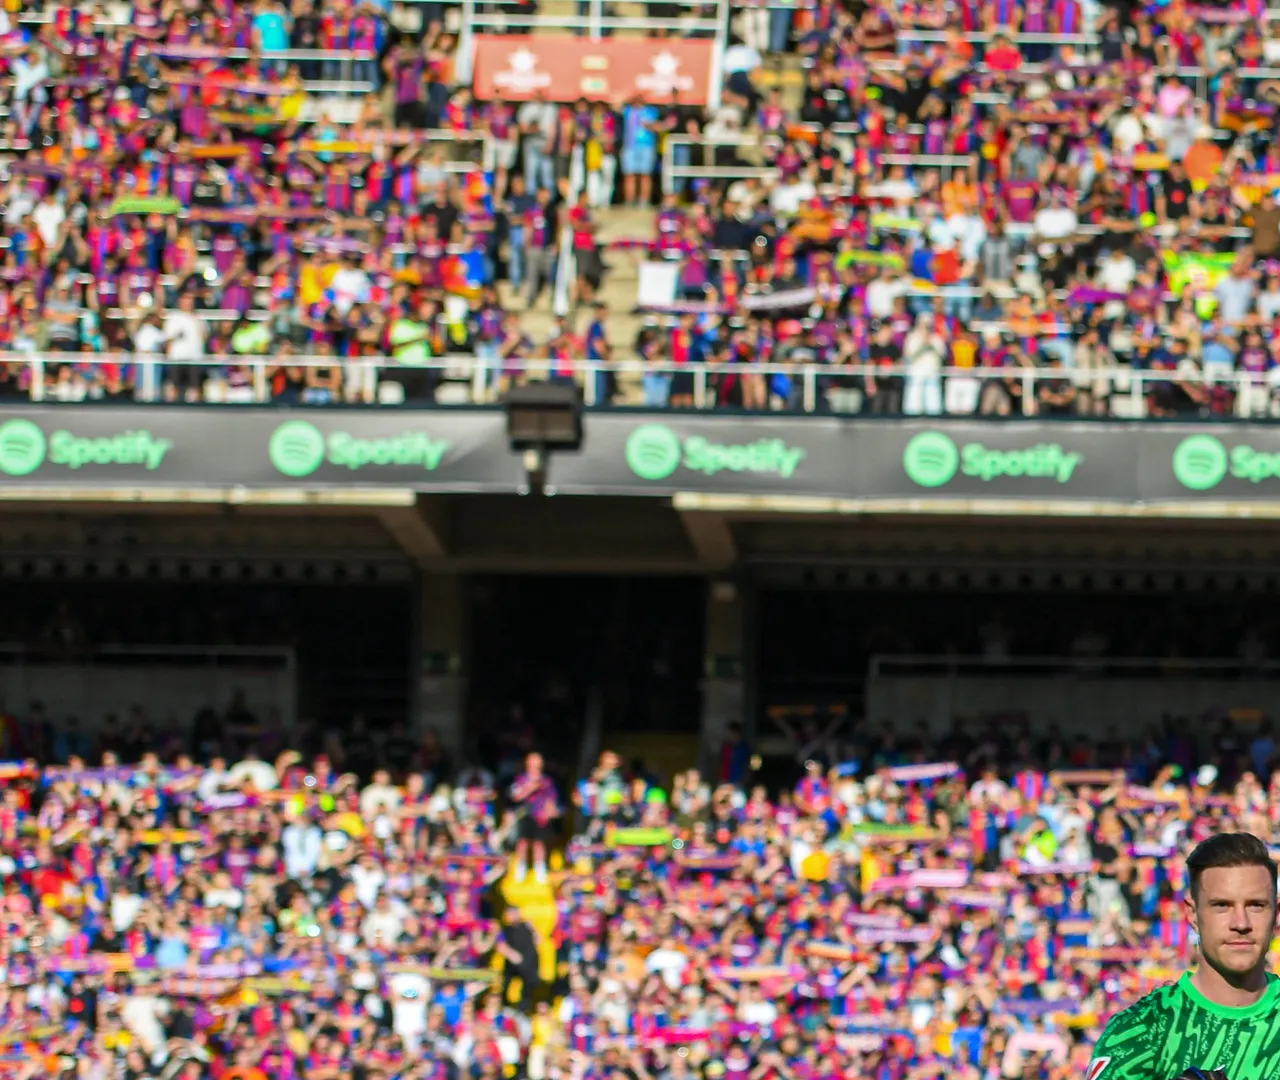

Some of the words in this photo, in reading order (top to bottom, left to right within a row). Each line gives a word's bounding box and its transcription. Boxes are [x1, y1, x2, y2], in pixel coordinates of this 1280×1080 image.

[50, 430, 170, 469] Spotify
[328, 430, 450, 470] Spotify
[683, 433, 803, 477] Spotify
[961, 441, 1080, 482] Spotify
